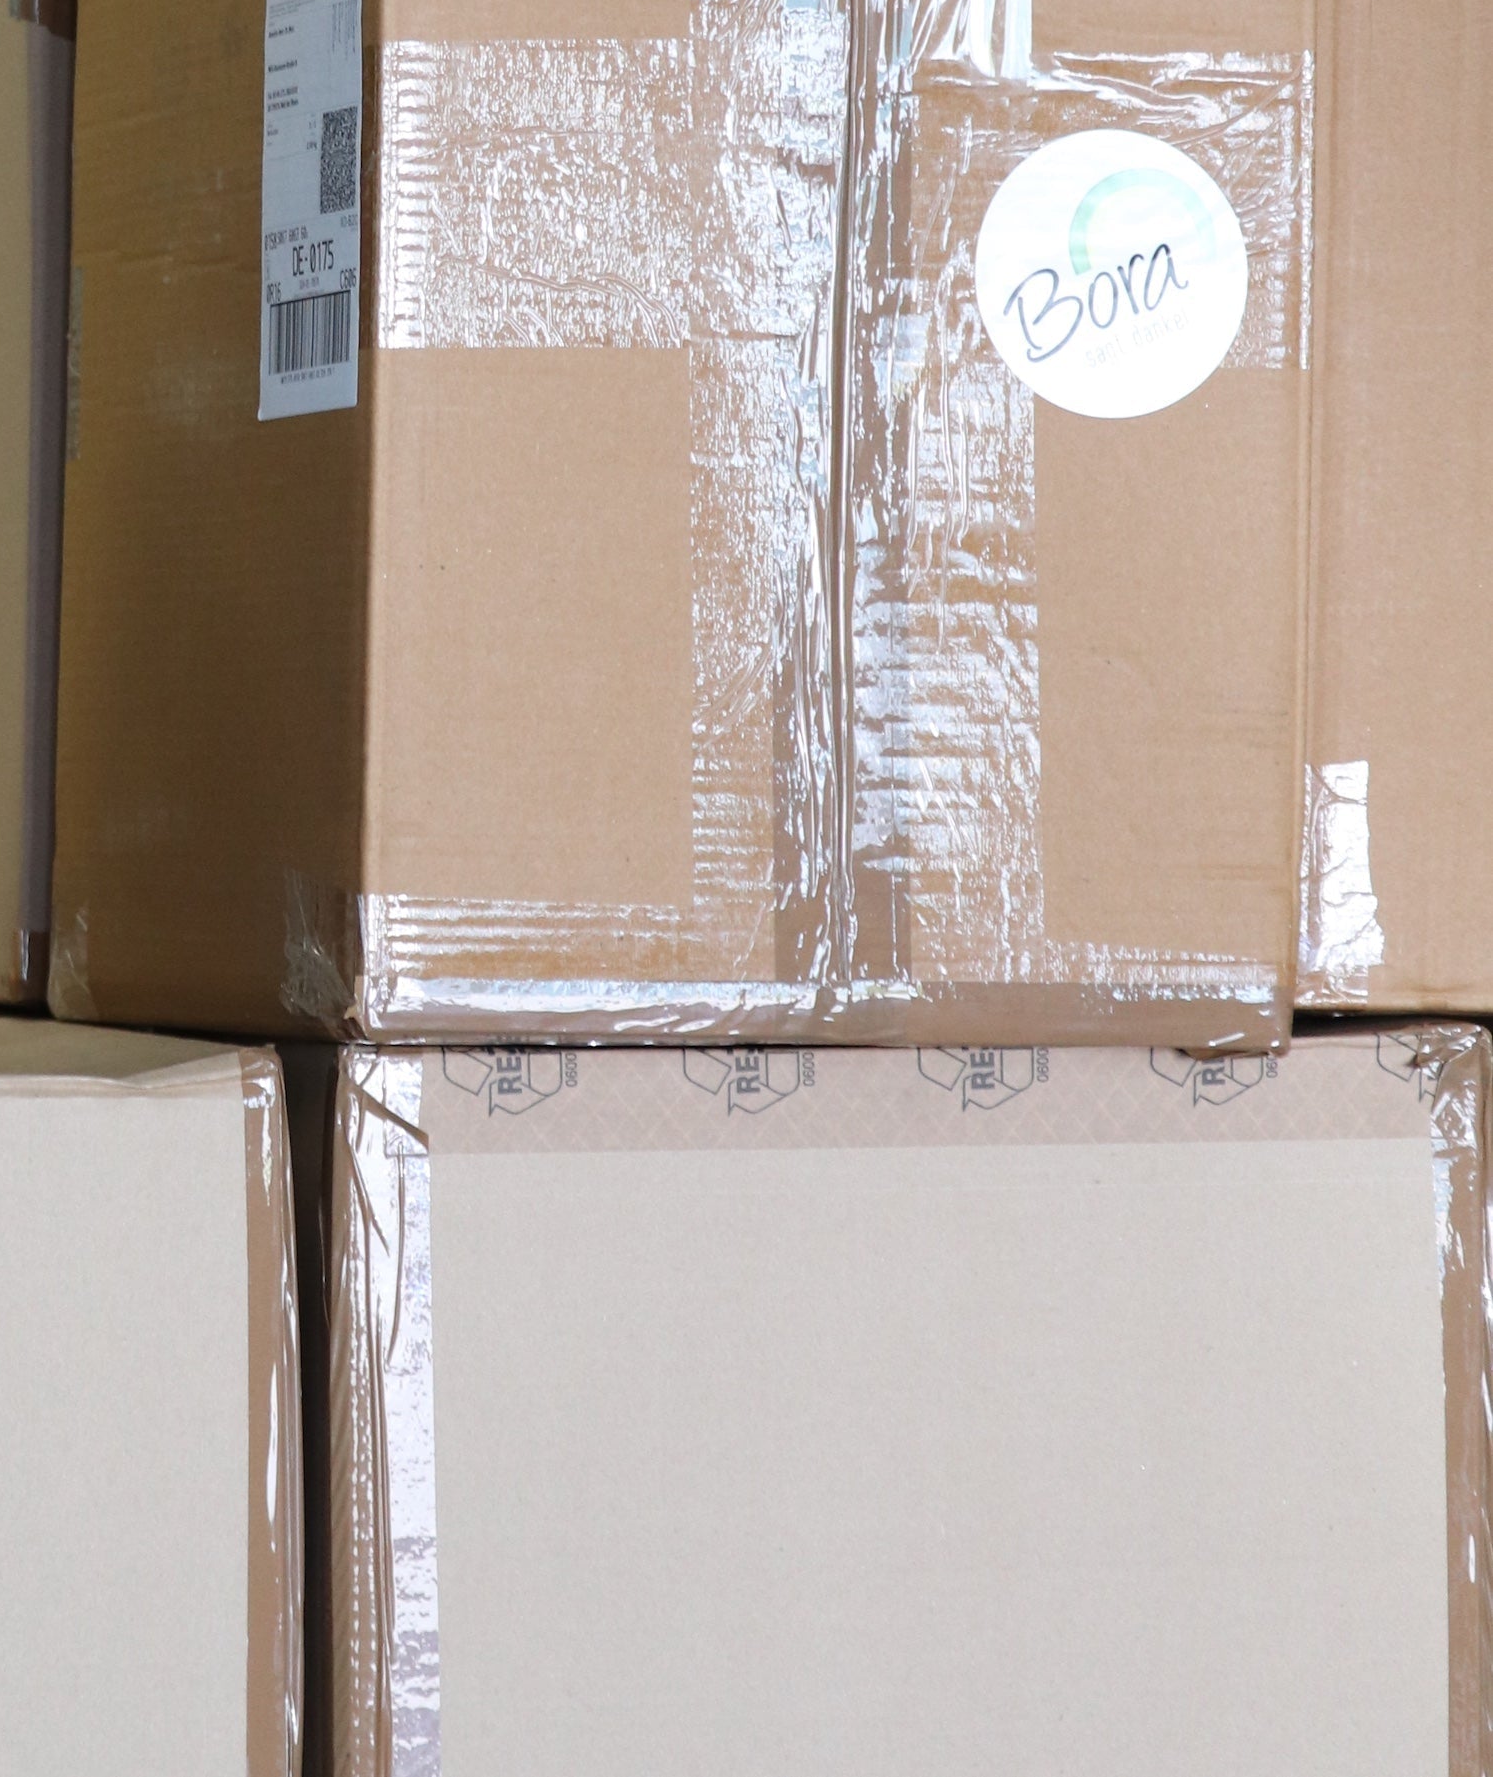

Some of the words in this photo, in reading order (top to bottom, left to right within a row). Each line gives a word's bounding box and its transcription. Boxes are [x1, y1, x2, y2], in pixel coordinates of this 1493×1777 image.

[292, 240, 335, 276] DE-0175
[1002, 243, 1190, 363] Bora
[565, 1051, 578, 1087] 0600
[802, 1052, 815, 1087] 0600
